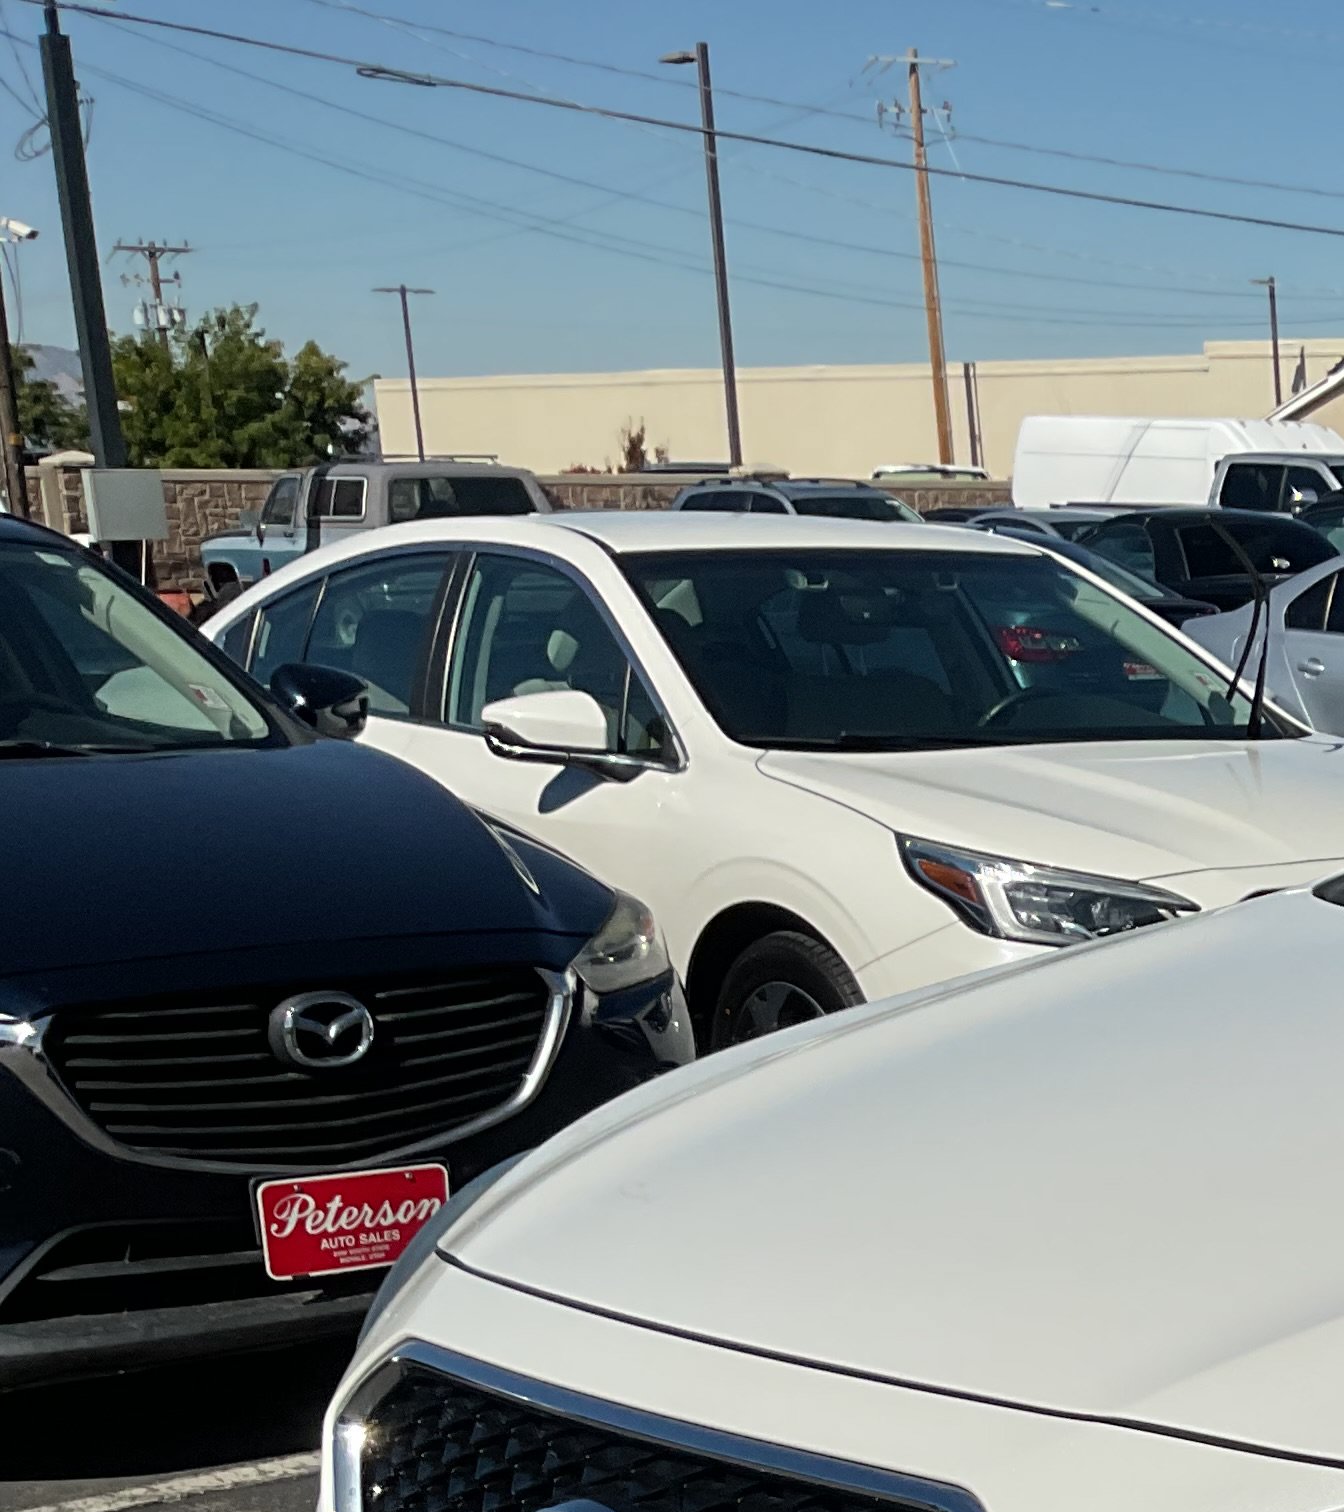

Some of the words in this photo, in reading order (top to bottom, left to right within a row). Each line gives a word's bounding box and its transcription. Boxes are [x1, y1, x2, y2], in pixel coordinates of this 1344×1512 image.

[270, 1193, 441, 1238] Peterson
[320, 1236, 355, 1251] AUTO
[359, 1229, 401, 1246] SALES
